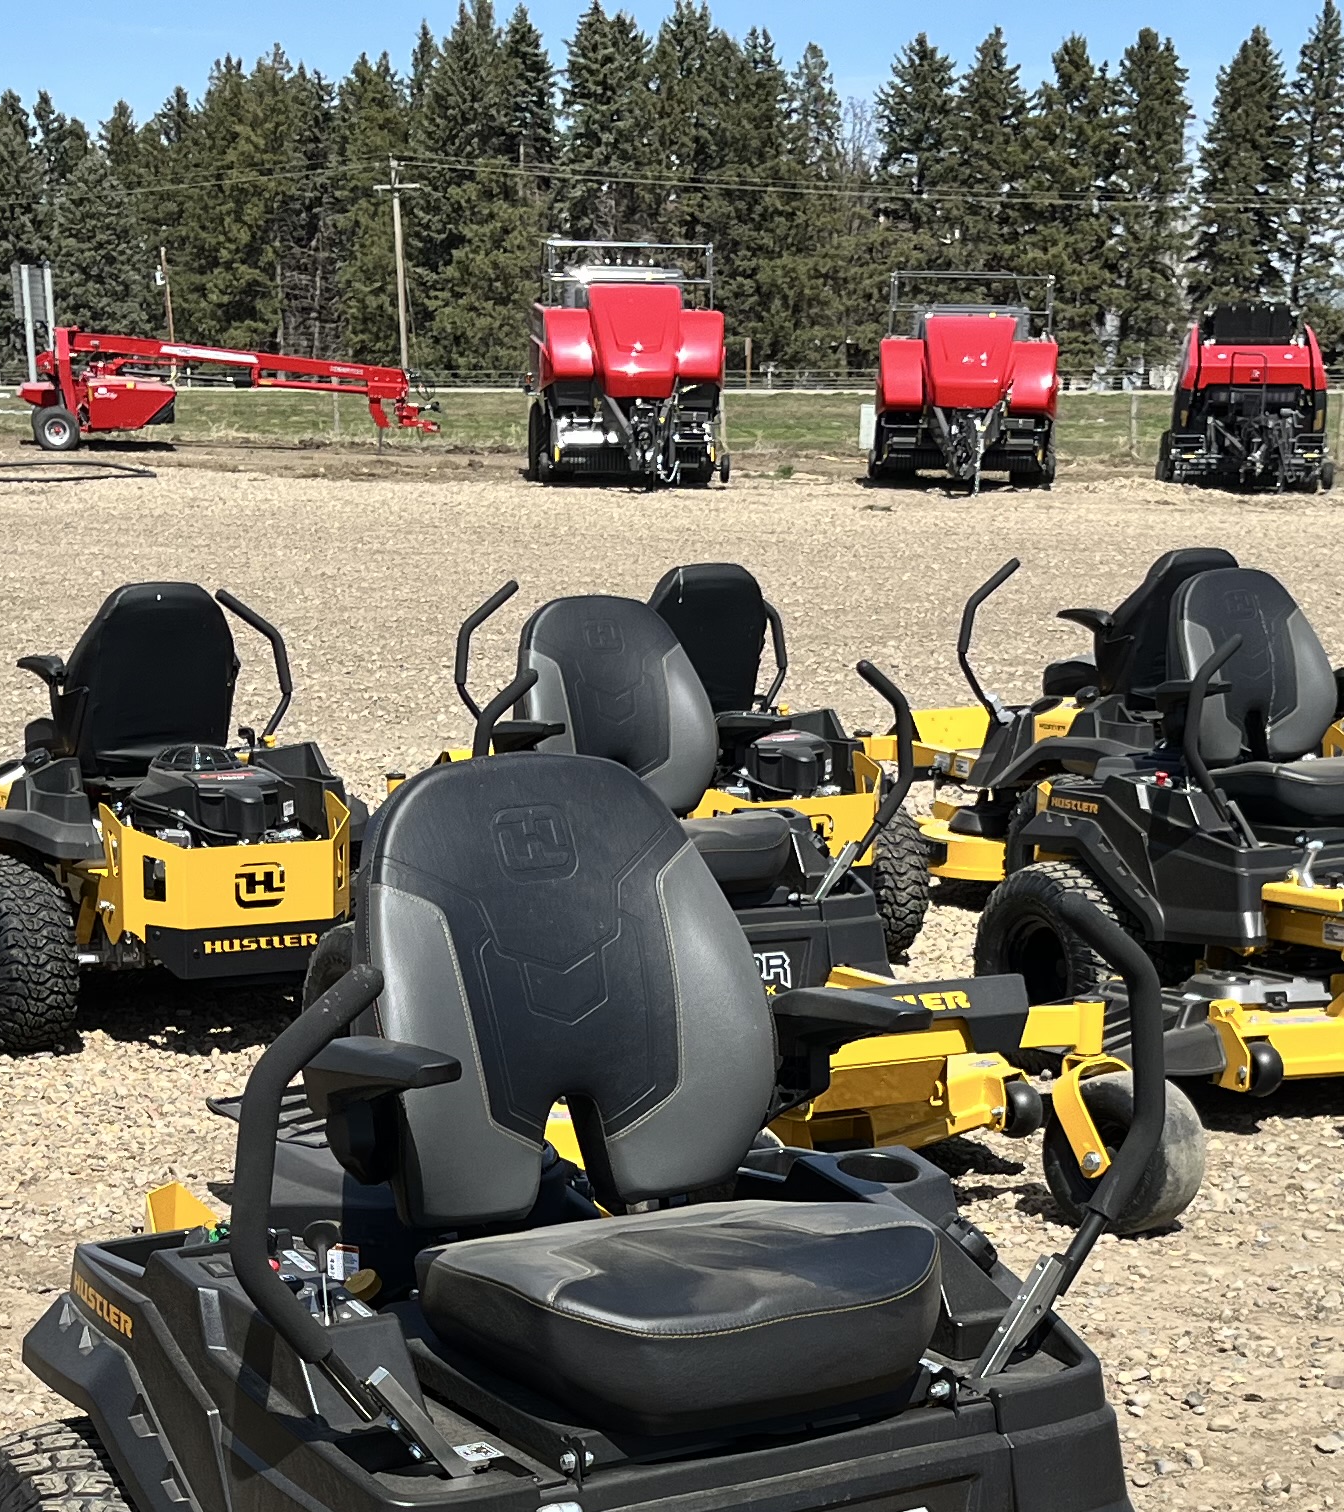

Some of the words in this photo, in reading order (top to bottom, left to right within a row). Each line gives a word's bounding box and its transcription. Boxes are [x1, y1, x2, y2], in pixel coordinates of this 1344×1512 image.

[1051, 797, 1099, 814] HUSTLER
[203, 933, 318, 955] HUSTLER
[73, 1270, 133, 1340] HUSTLER
